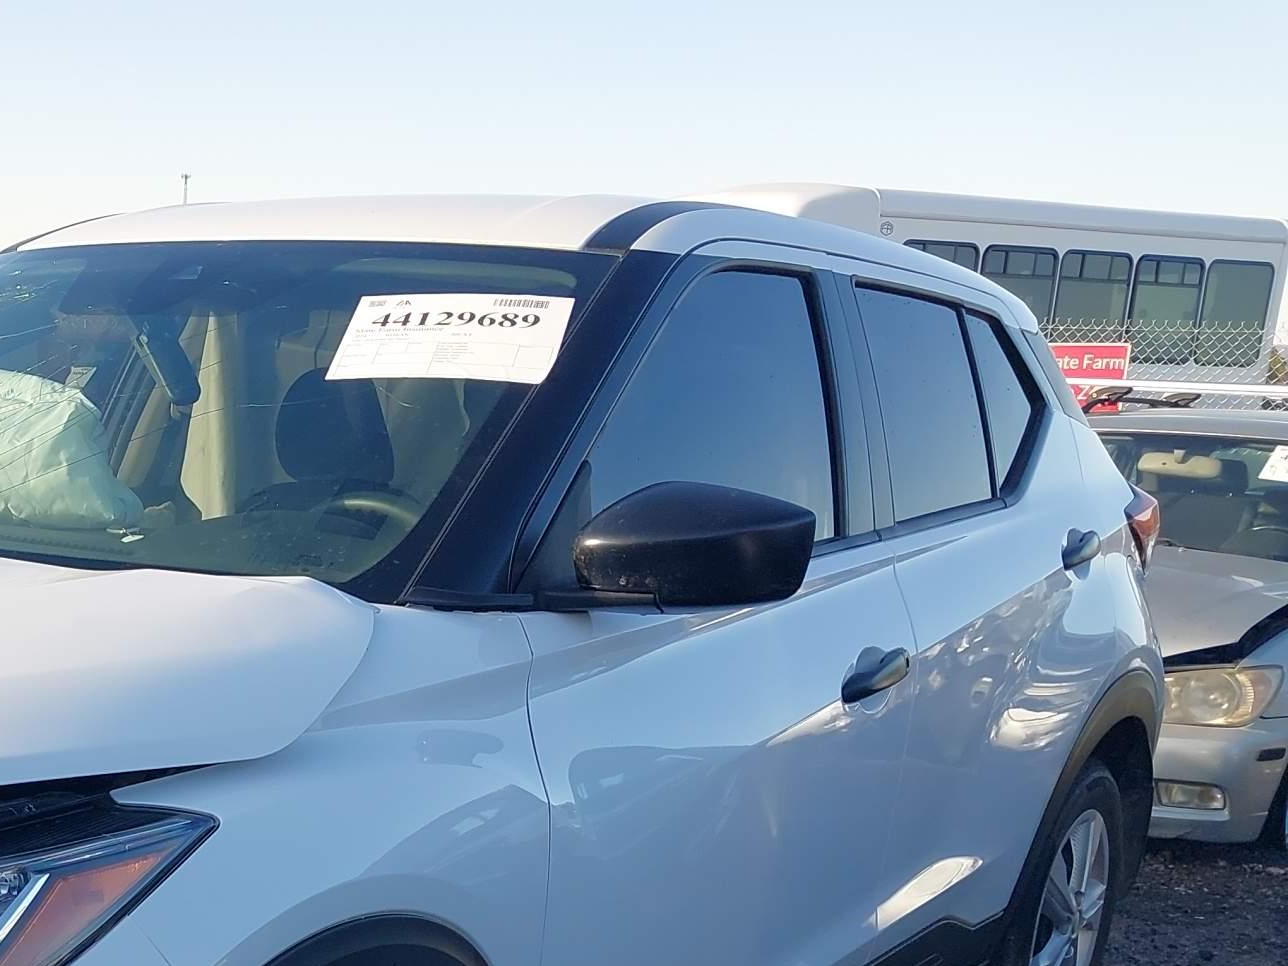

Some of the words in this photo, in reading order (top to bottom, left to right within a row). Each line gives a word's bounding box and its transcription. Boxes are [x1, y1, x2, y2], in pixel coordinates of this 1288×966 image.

[371, 311, 541, 329] 44129689
[1056, 355, 1079, 370] ate
[1082, 354, 1124, 370] Farm
